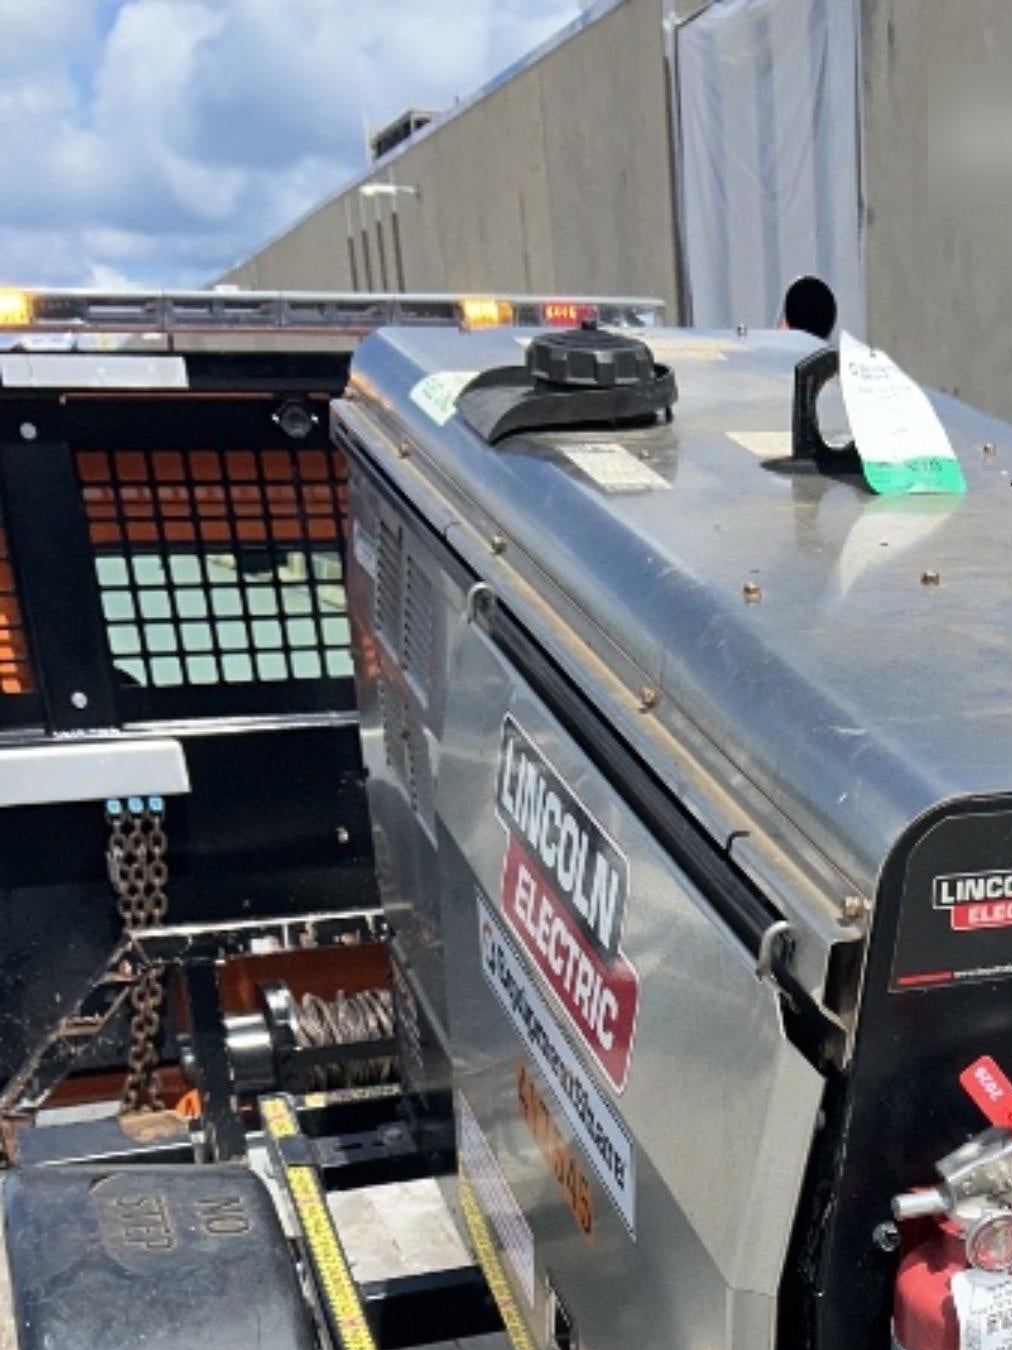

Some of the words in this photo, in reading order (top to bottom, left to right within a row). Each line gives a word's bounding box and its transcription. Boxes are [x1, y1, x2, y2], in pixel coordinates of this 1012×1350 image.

[502, 737, 619, 950] LINCOLN
[513, 863, 619, 1052] ELECTRIC
[112, 1195, 177, 1250] STEP
[195, 1195, 252, 1237] NO
